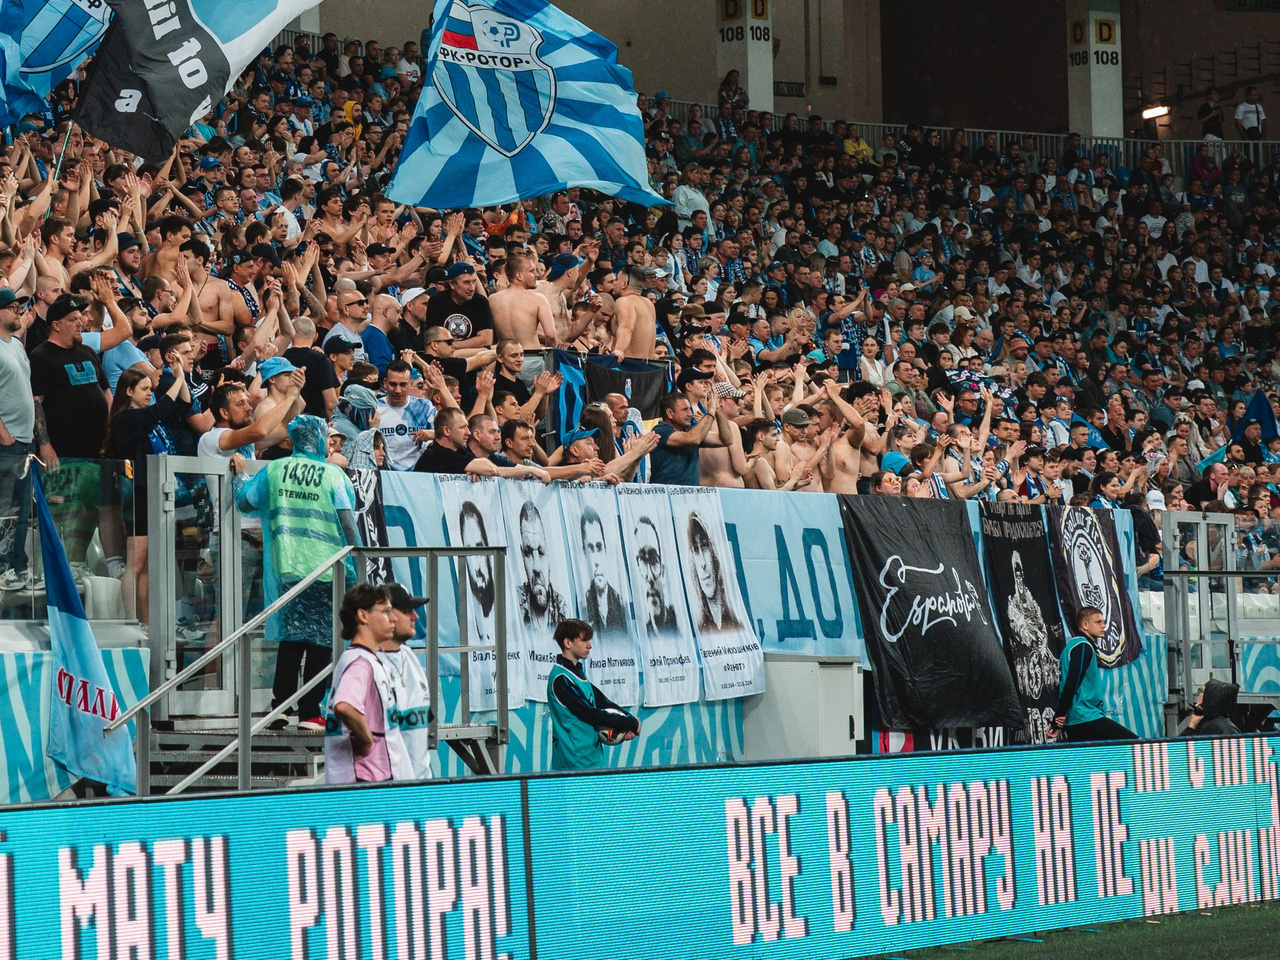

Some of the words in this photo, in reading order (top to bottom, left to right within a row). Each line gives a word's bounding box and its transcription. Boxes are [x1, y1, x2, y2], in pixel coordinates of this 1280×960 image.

[718, 26, 744, 43] 108
[749, 25, 770, 42] 108
[1073, 21, 1083, 44] D
[1099, 21, 1112, 42] D
[1069, 50, 1089, 67] 108
[1094, 50, 1119, 66] 108
[282, 461, 325, 488] 14303
[278, 489, 320, 502] STEWARD
[724, 792, 806, 945] ВСЕ
[827, 790, 854, 931] В
[873, 779, 1016, 926] САМАРУ
[1032, 774, 1077, 905] НА
[58, 835, 230, 960] МАТЧ
[285, 813, 514, 960] РОТОРА!
